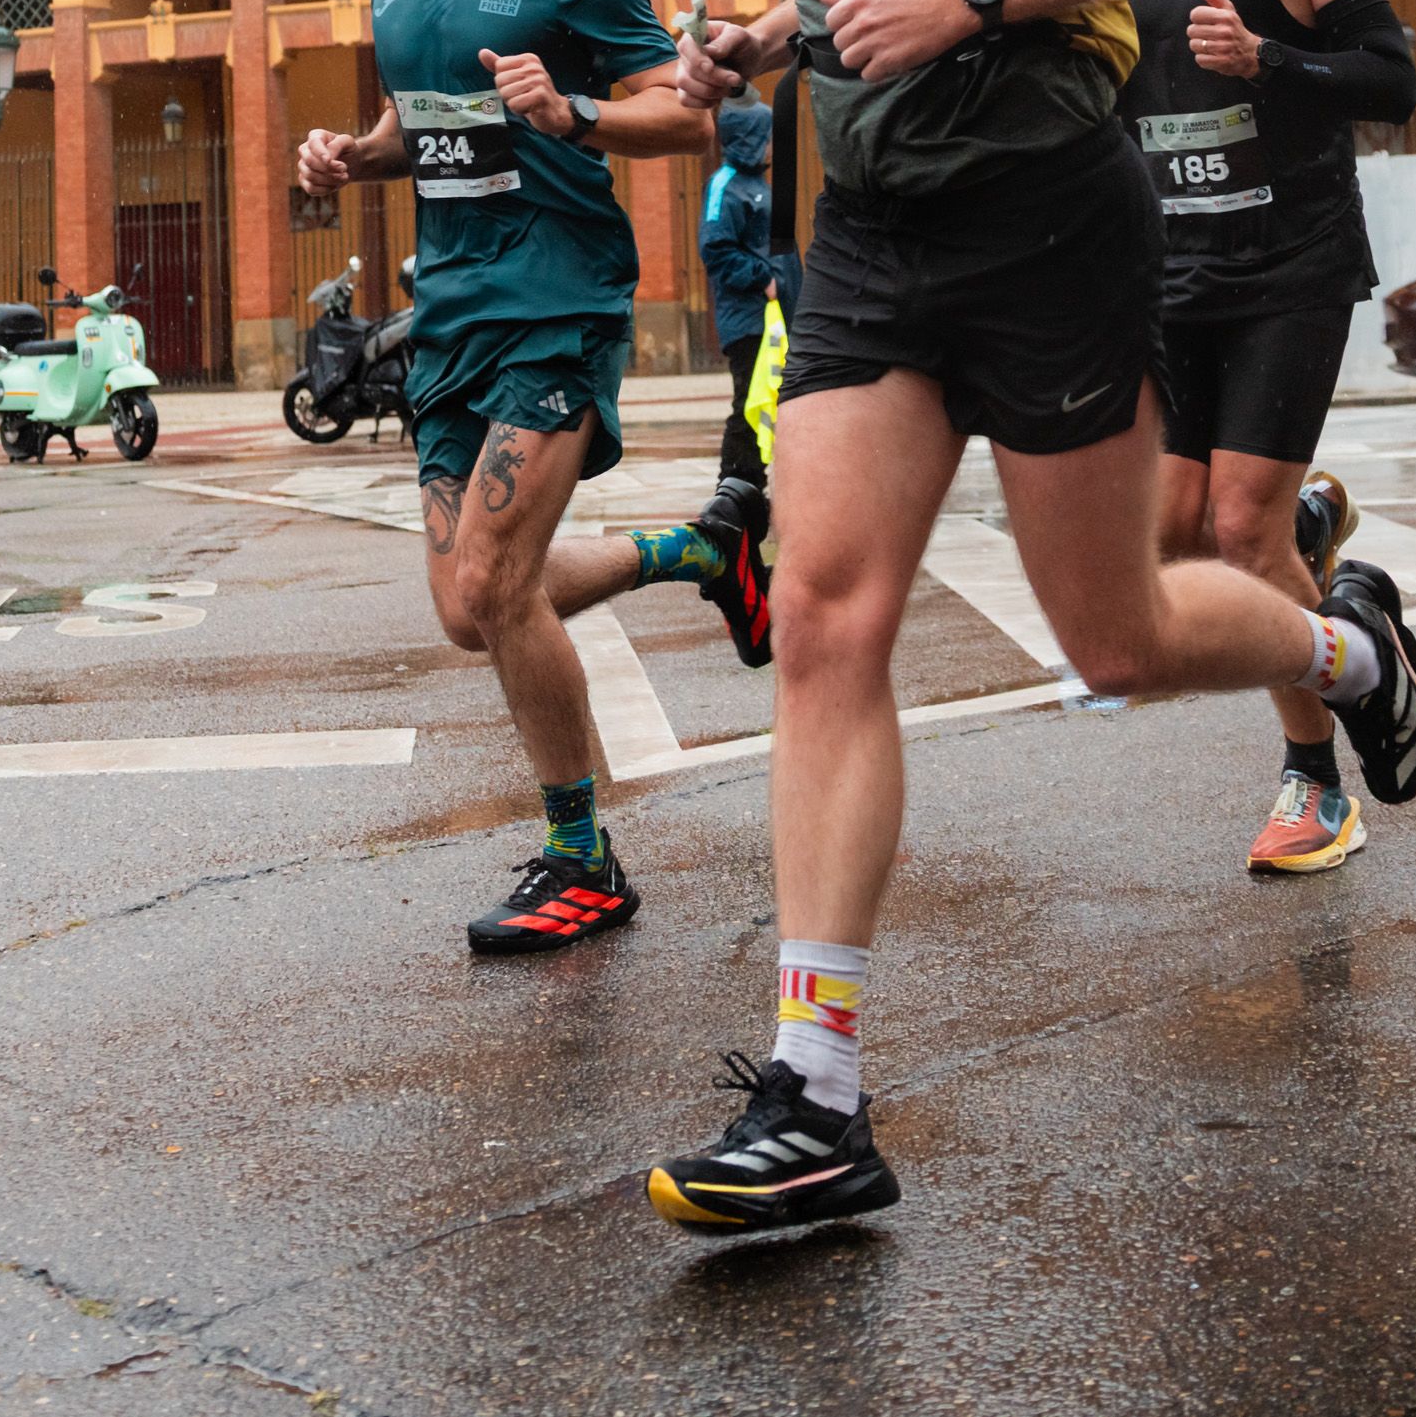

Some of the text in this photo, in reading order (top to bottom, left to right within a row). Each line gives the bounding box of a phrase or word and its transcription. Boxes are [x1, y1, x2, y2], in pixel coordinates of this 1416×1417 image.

[481, 1, 515, 14] FILTER
[412, 98, 428, 112] 42
[1161, 122, 1175, 134] 42
[418, 135, 475, 165] 234
[1169, 153, 1230, 185] 185
